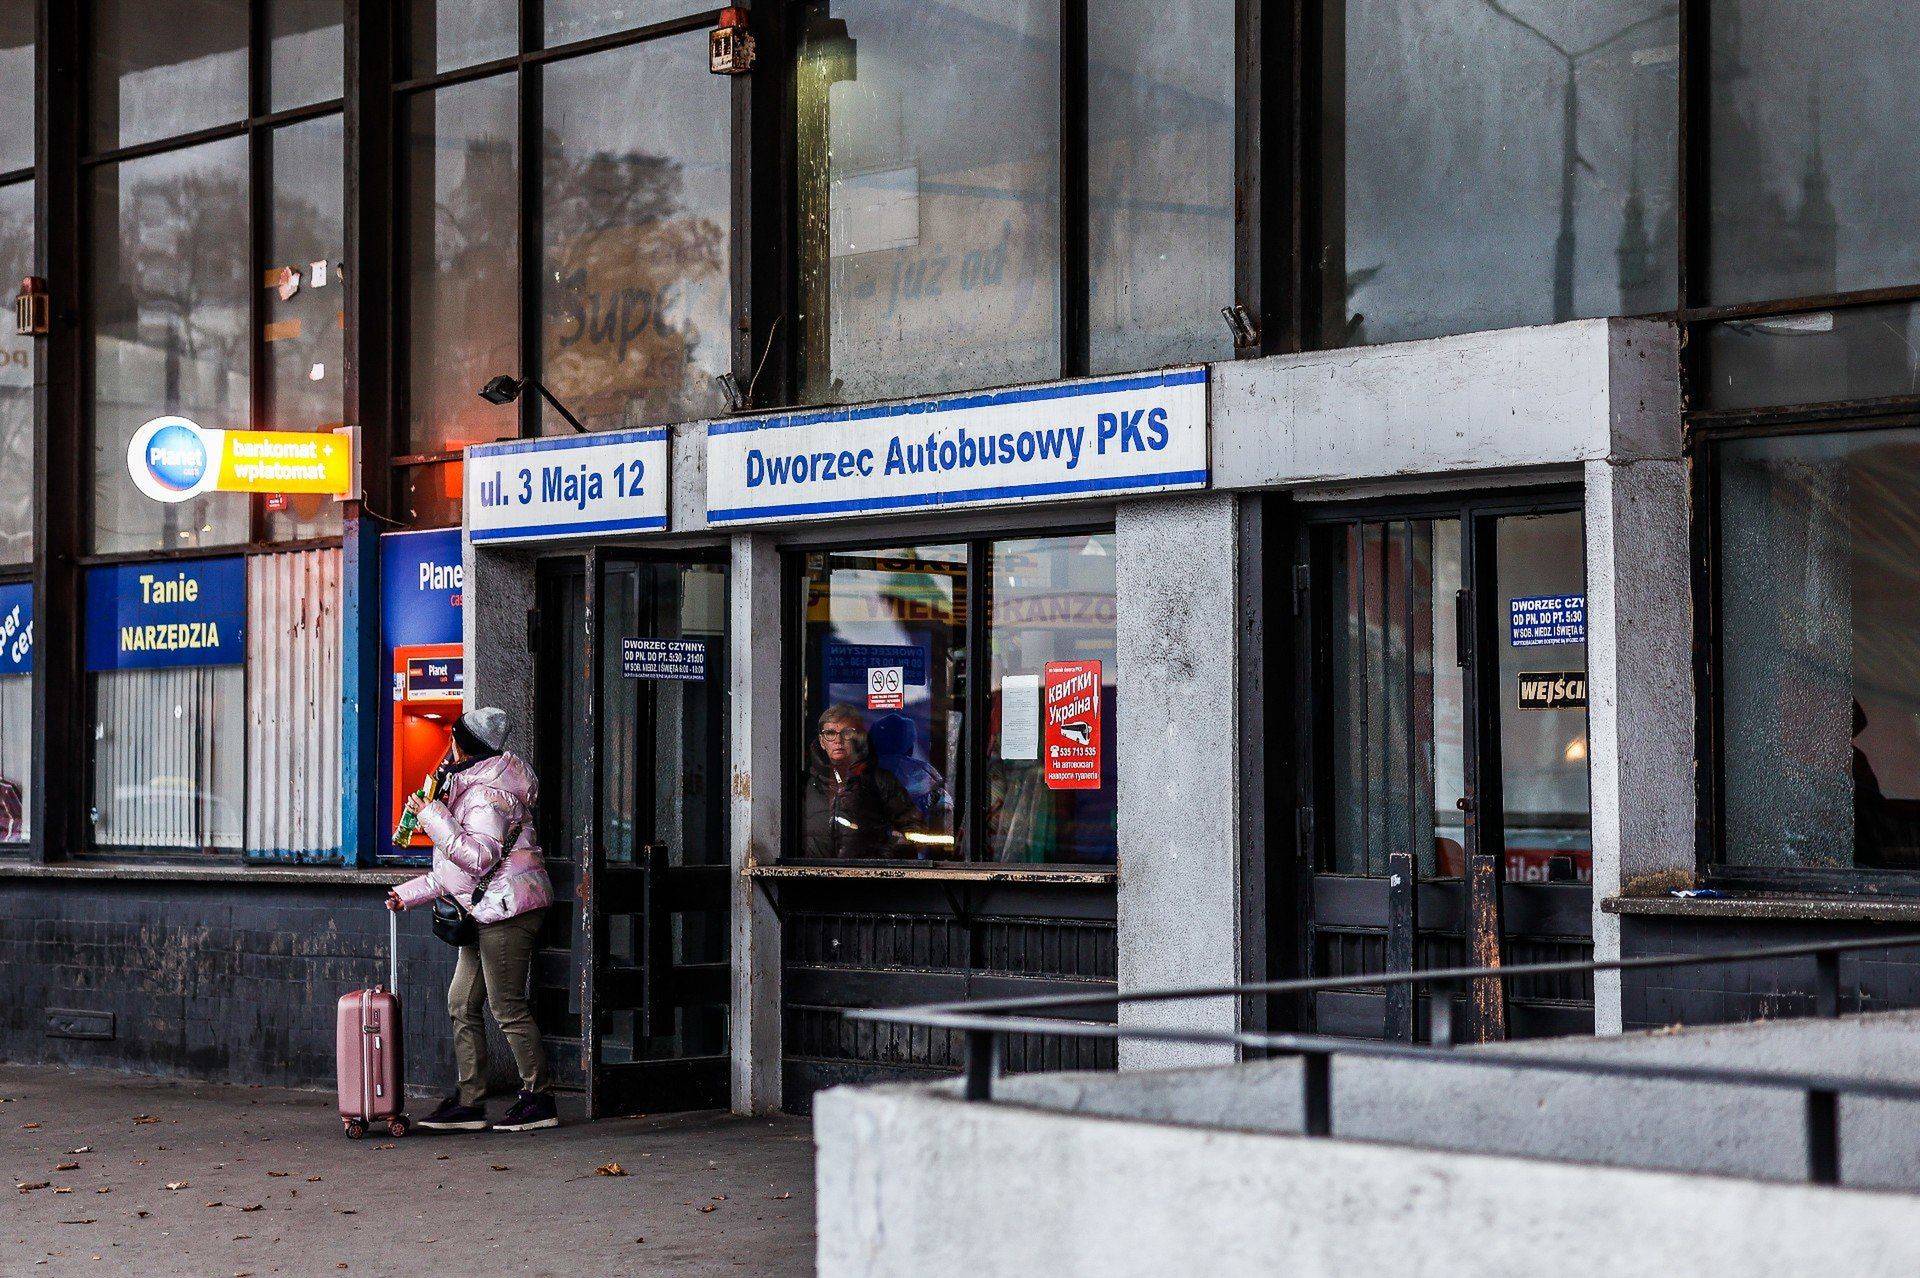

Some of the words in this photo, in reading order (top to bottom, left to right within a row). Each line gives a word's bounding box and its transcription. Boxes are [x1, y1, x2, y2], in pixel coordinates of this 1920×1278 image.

[150, 447, 203, 467] Planet
[232, 438, 317, 459] bankomat
[746, 448, 874, 488] Dworzec
[883, 425, 1084, 476] Autobusowy
[1097, 406, 1169, 455] PKS
[480, 471, 509, 507] ul.
[518, 468, 532, 505] 3
[542, 464, 603, 510] Maja
[613, 459, 645, 498] 12
[419, 561, 463, 591] Plane
[139, 572, 199, 604] Tanie
[1512, 598, 1562, 612] DWORZEC
[1564, 598, 1584, 608] CZY
[1513, 614, 1524, 626] OD
[1526, 613, 1538, 625] PN.
[1540, 612, 1551, 624] DO
[1552, 612, 1564, 624] PT.
[1566, 610, 1582, 622] 5:30
[121, 622, 220, 652] NARZĘDZIA
[1513, 628, 1520, 638] W
[1520, 628, 1534, 638] SOB.
[1534, 626, 1552, 637] NIEDZ.
[1556, 624, 1578, 638] ŚWIĘTA
[624, 640, 666, 650] DWORZEC
[668, 642, 705, 652] CZYNNY:
[624, 651, 634, 661] OD
[648, 652, 656, 662] DO
[658, 652, 668, 662] PT.
[668, 653, 682, 662] 5:30
[428, 664, 448, 676] Planet
[1048, 670, 1092, 704] КВИТКИ
[1049, 696, 1091, 726] Україна
[1060, 748, 1072, 757] 535
[1072, 748, 1084, 756] 713
[1084, 747, 1096, 756] 535
[1052, 760, 1061, 768] На
